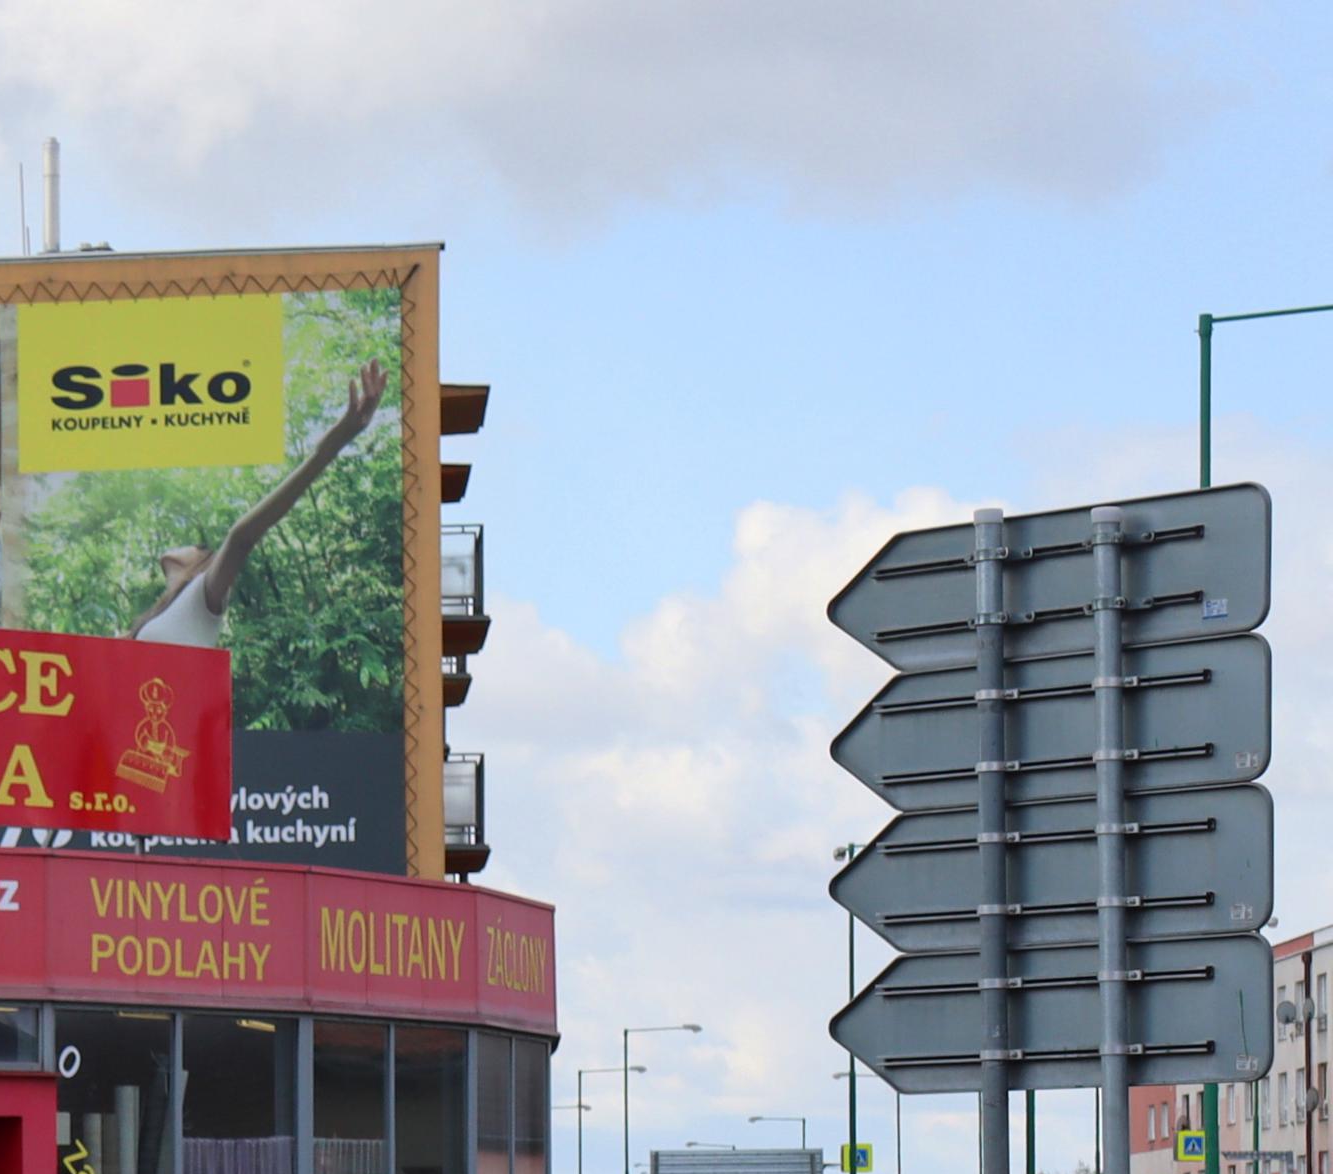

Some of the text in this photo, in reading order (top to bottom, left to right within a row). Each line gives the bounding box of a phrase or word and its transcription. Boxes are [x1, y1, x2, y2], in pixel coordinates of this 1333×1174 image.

[51, 407, 250, 432] KOUPELNY KUCHYNĚ
[69, 790, 137, 814] s.r.o.
[246, 817, 357, 849] kuchyní
[90, 877, 270, 926] VINYLOVÉ
[91, 933, 272, 982] PODLAHY
[321, 906, 465, 982] MOLITANY
[486, 917, 547, 994] ZÁCLONY
